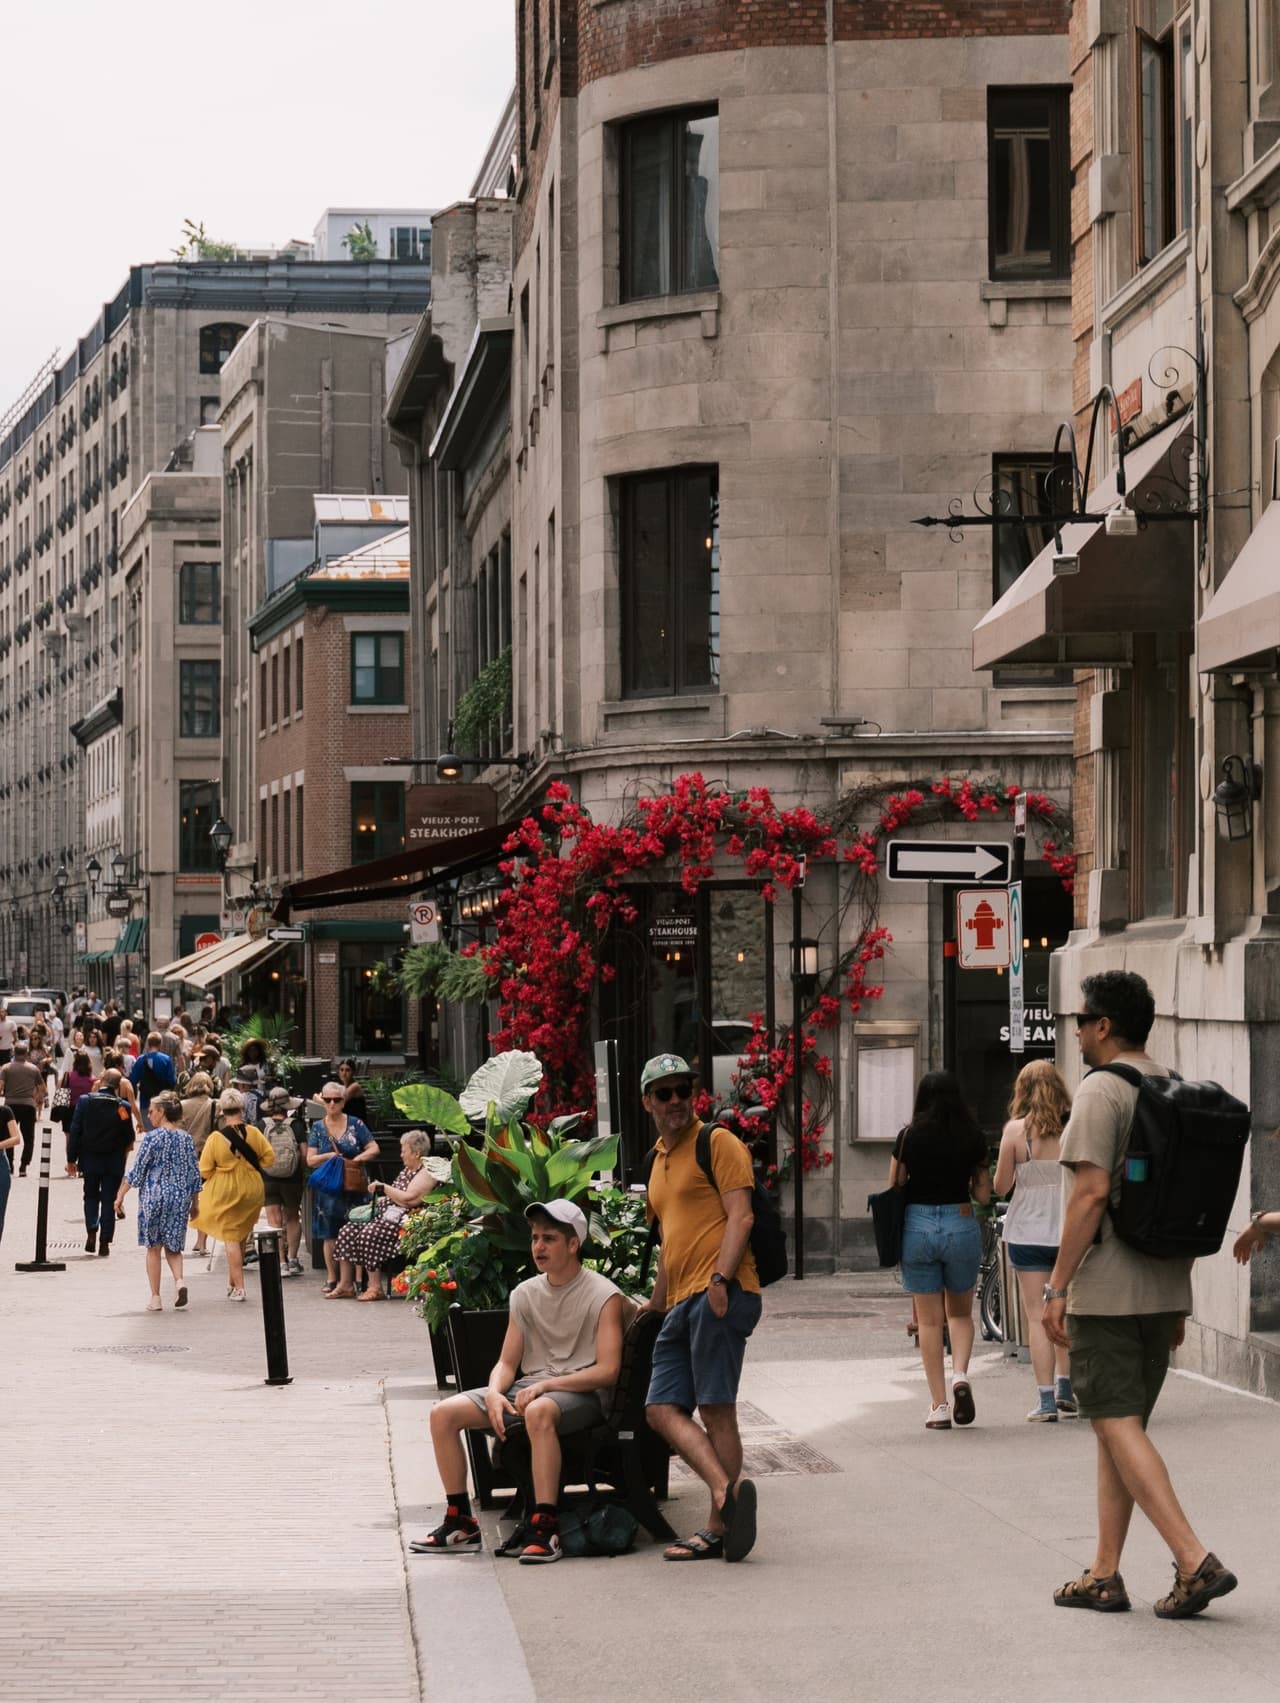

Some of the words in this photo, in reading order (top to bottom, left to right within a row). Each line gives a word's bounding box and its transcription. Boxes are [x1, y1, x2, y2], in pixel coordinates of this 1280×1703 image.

[409, 827, 485, 838] STEAKHOU
[649, 927, 698, 936] STEAKHOUSE
[1023, 1008, 1056, 1021] VIEU
[1000, 1026, 1056, 1042] SEAK
